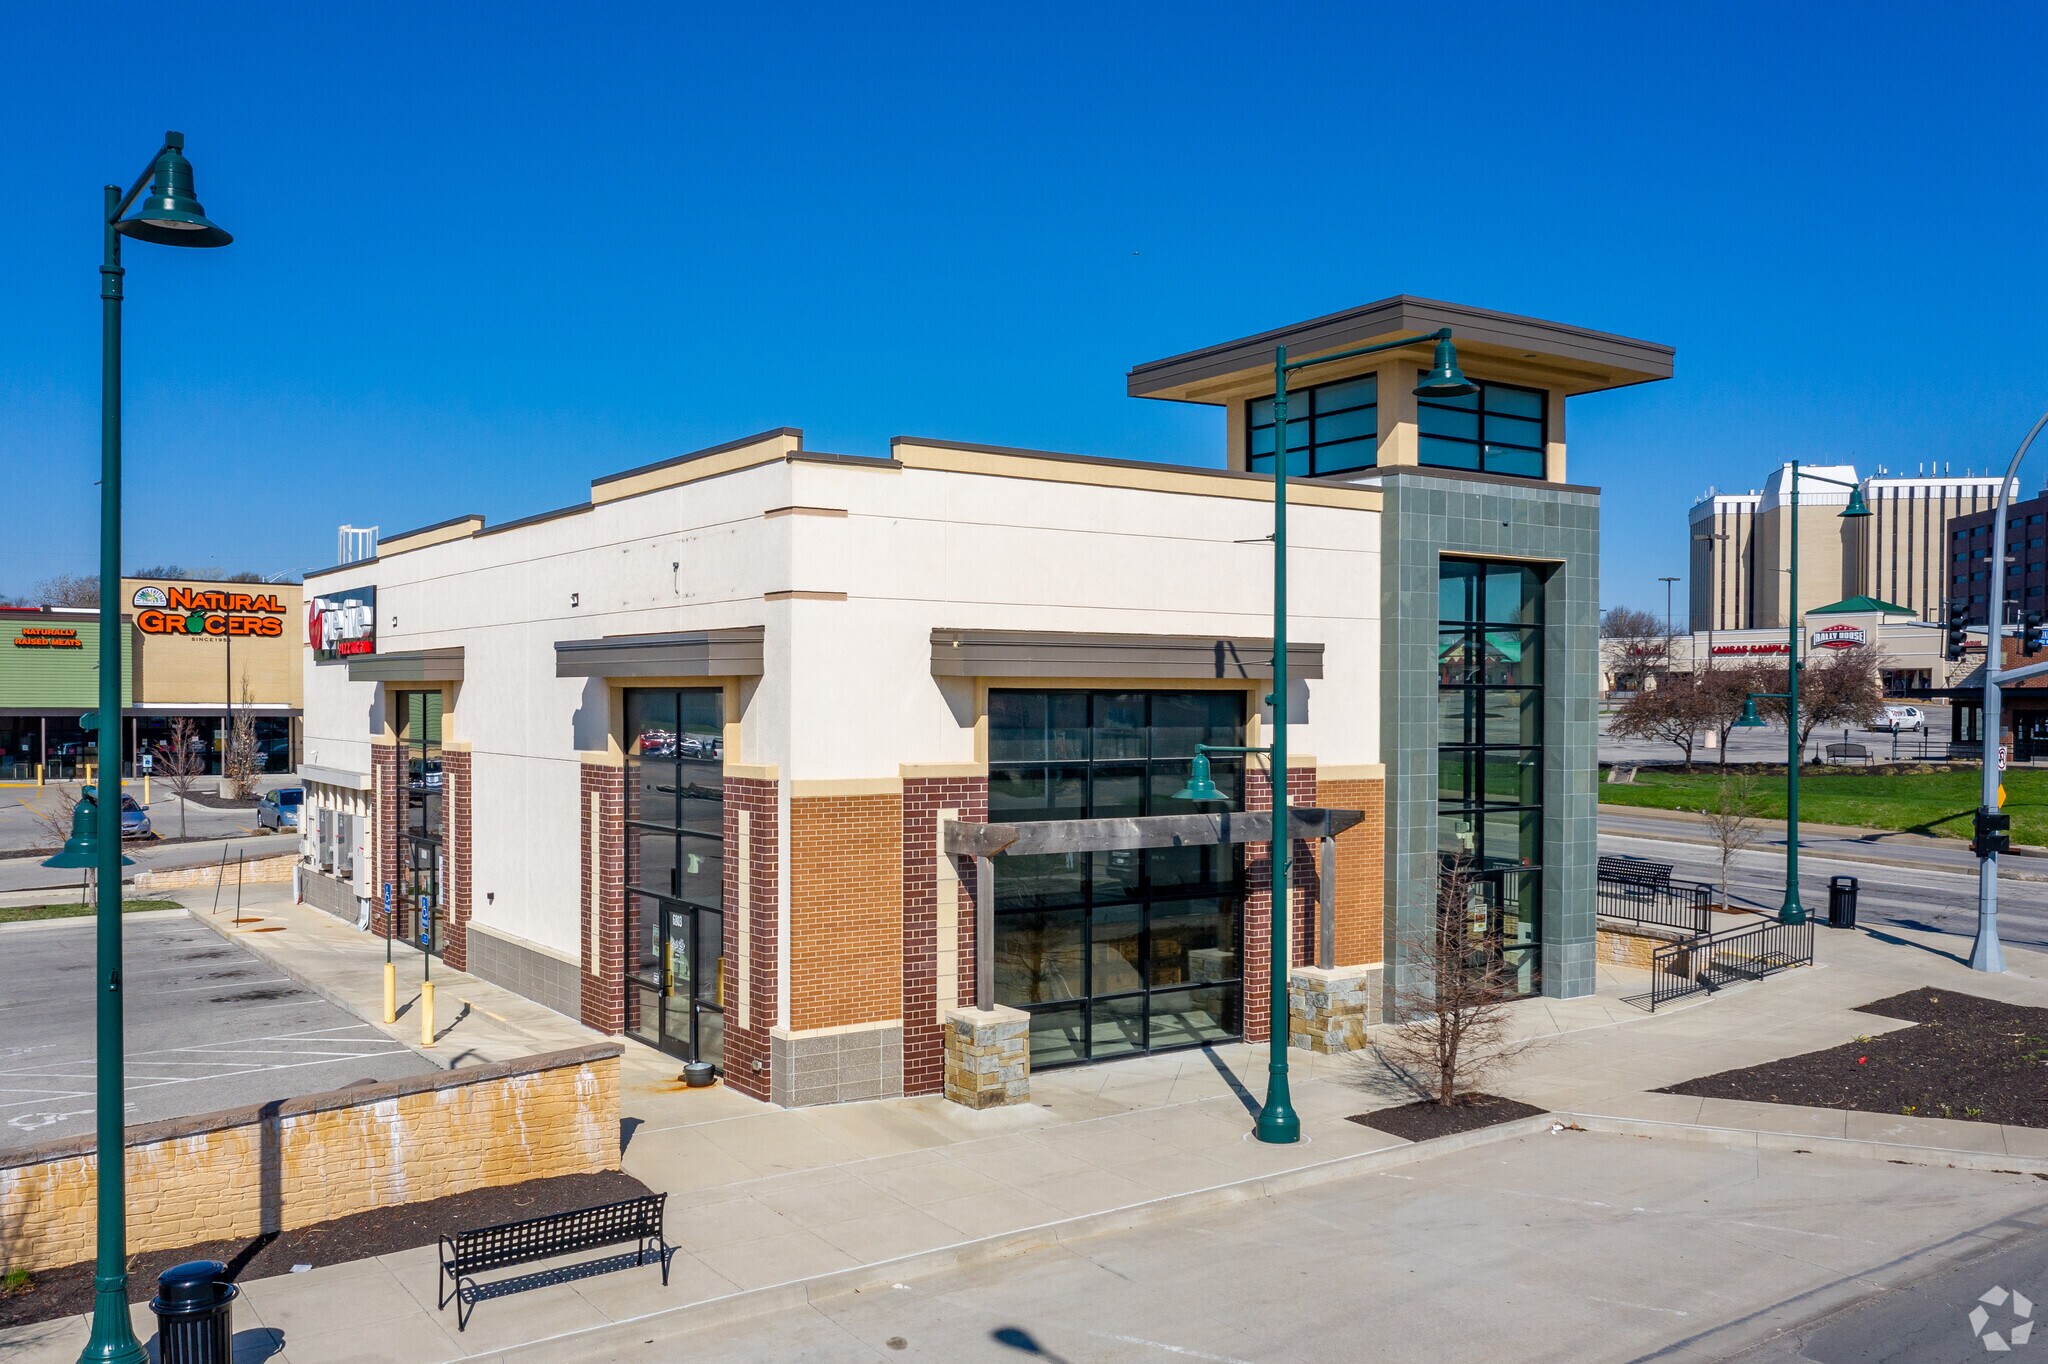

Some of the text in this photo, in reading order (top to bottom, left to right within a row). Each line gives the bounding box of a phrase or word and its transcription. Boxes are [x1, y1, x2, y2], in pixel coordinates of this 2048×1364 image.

[168, 587, 286, 613] NATURAL
[138, 610, 283, 636] GROCERS
[22, 628, 76, 636] NATURALLY
[1815, 631, 1864, 643] RALLY HOUSE
[51, 639, 81, 647] MEATS
[1712, 644, 1791, 654] KANSAS SAMPLE
